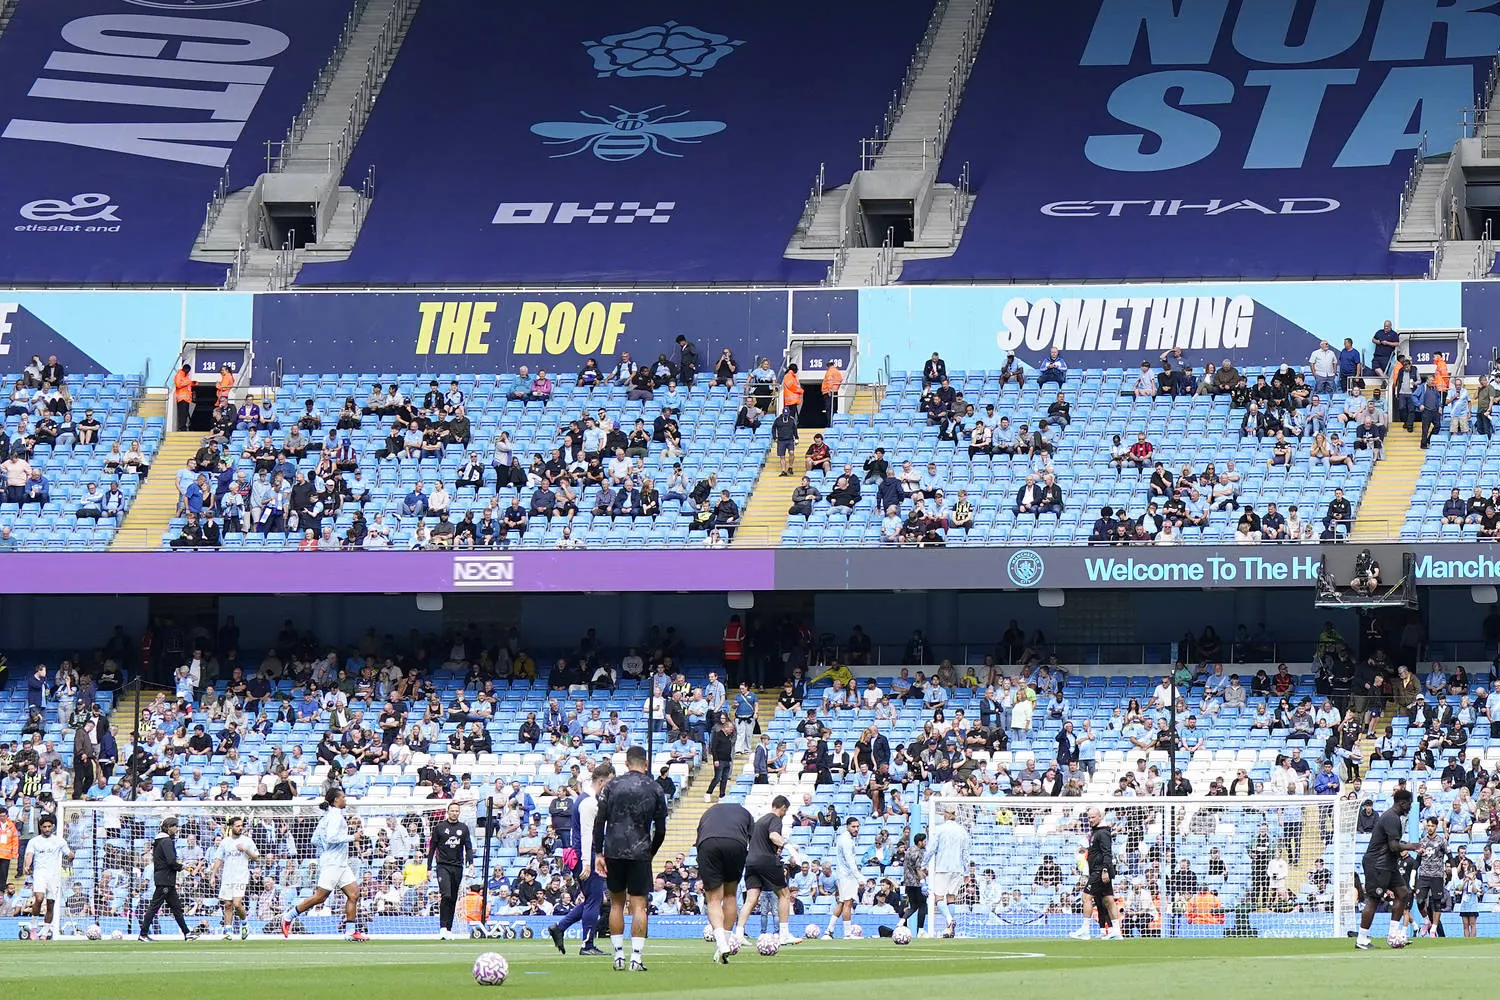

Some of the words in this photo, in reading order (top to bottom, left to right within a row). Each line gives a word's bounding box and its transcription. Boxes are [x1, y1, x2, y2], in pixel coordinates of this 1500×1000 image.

[2, 13, 290, 168] CITY
[491, 202, 676, 224] OKX
[1040, 196, 1341, 217] ETIHAD
[14, 224, 82, 232] etisalat
[415, 302, 497, 355] THE
[512, 301, 634, 355] ROOF
[997, 294, 1255, 351] SOMETHING
[454, 562, 514, 580] NEXEN
[1084, 557, 1204, 582] Welcome
[1207, 556, 1237, 580] To
[1239, 556, 1288, 580] The
